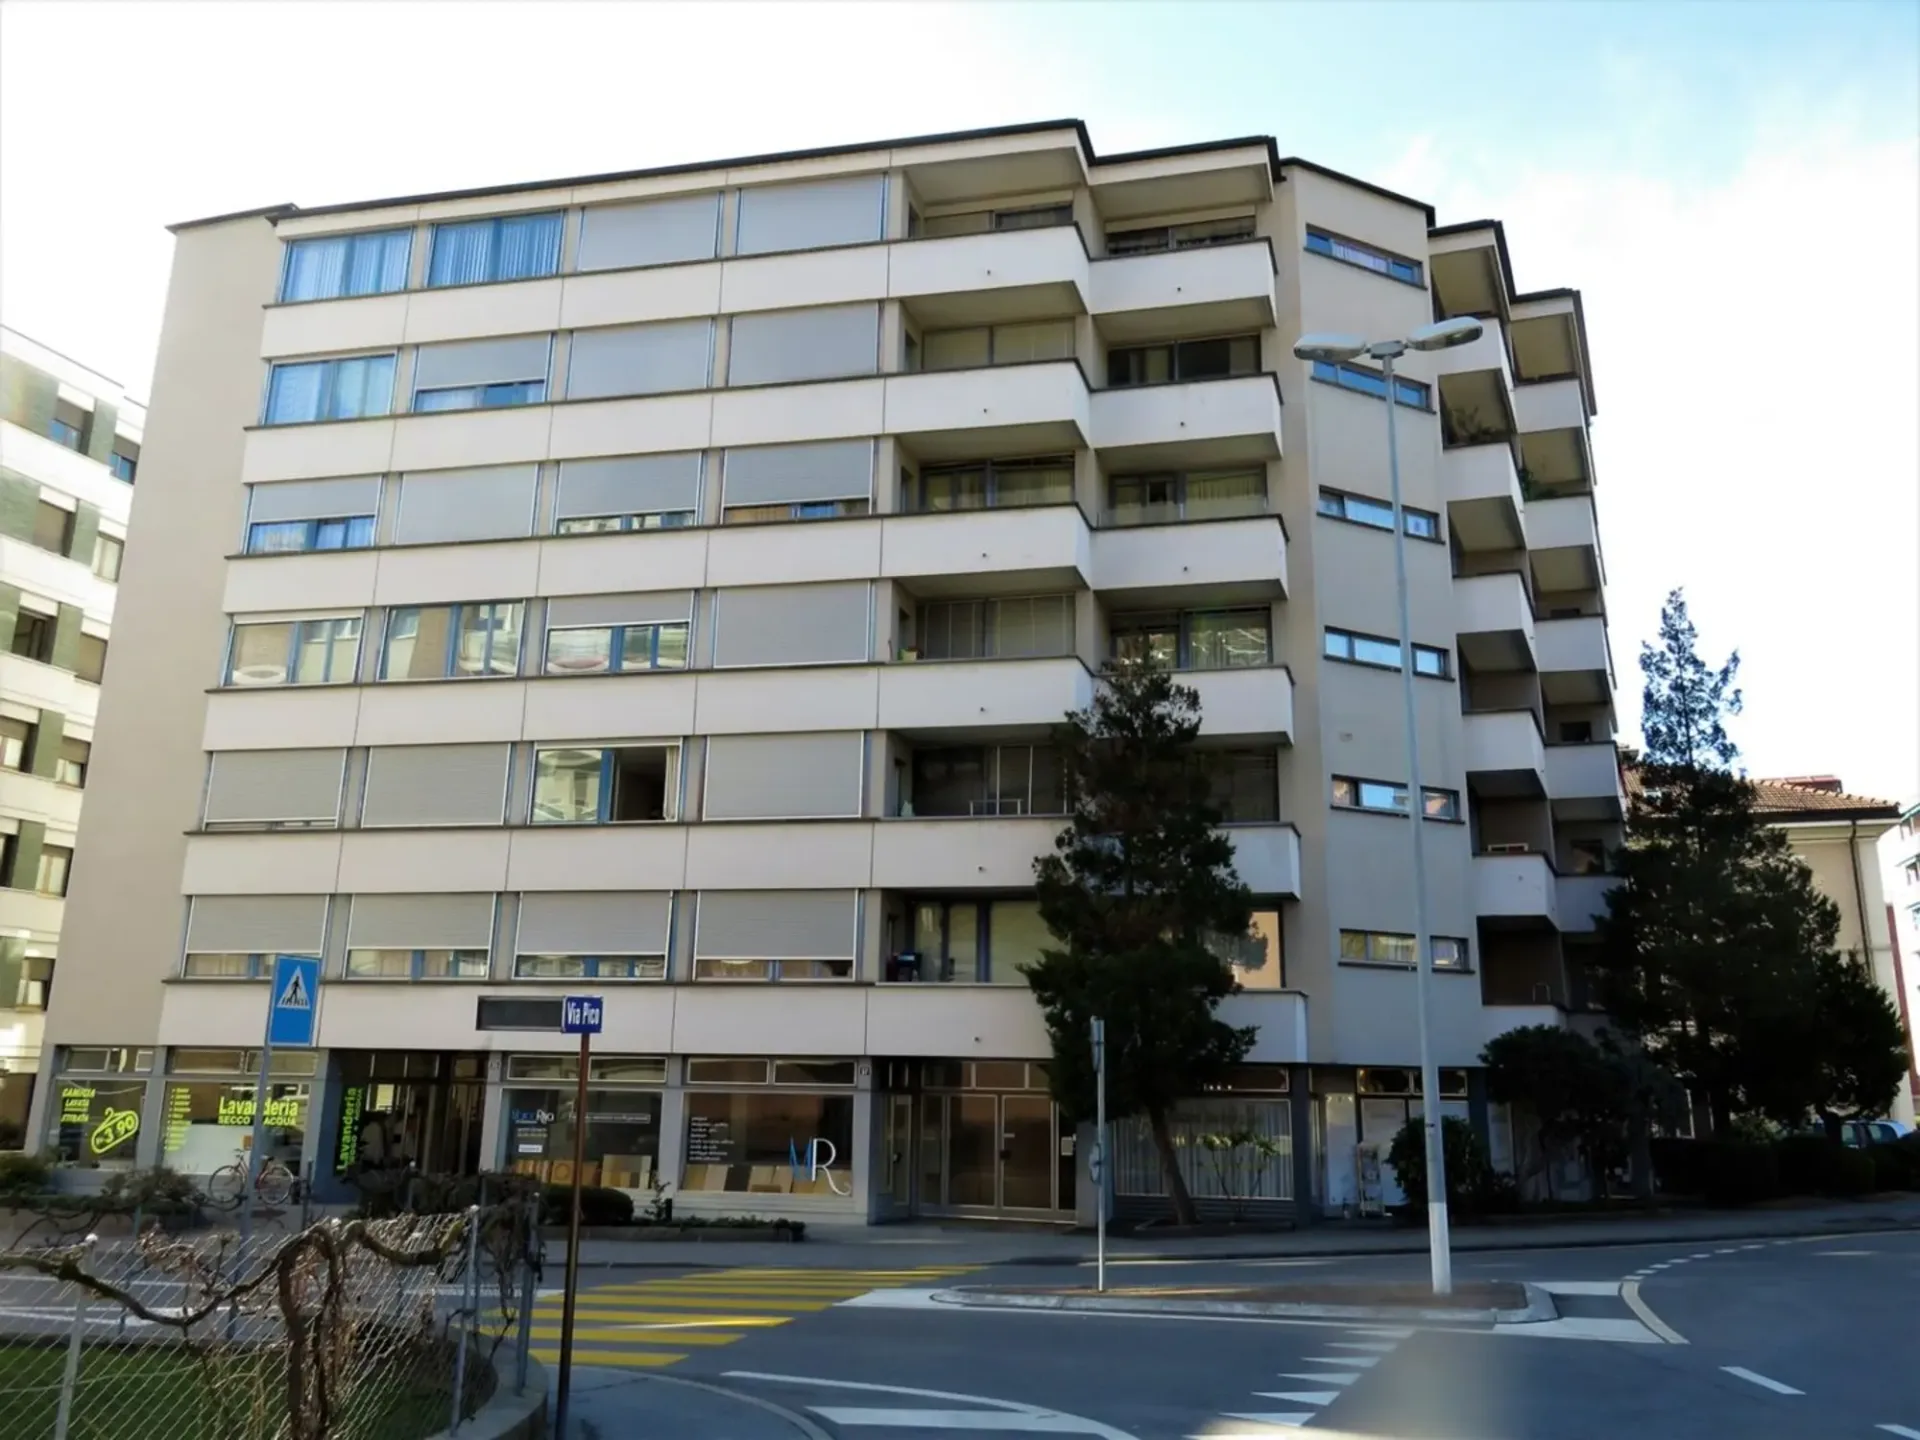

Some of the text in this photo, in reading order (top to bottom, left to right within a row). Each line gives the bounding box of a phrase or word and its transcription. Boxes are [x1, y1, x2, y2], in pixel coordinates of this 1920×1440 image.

[567, 1001, 600, 1025] Via Pico
[218, 1115, 297, 1126] SECCO ACQUA
[336, 1087, 357, 1170] Lavanderia
